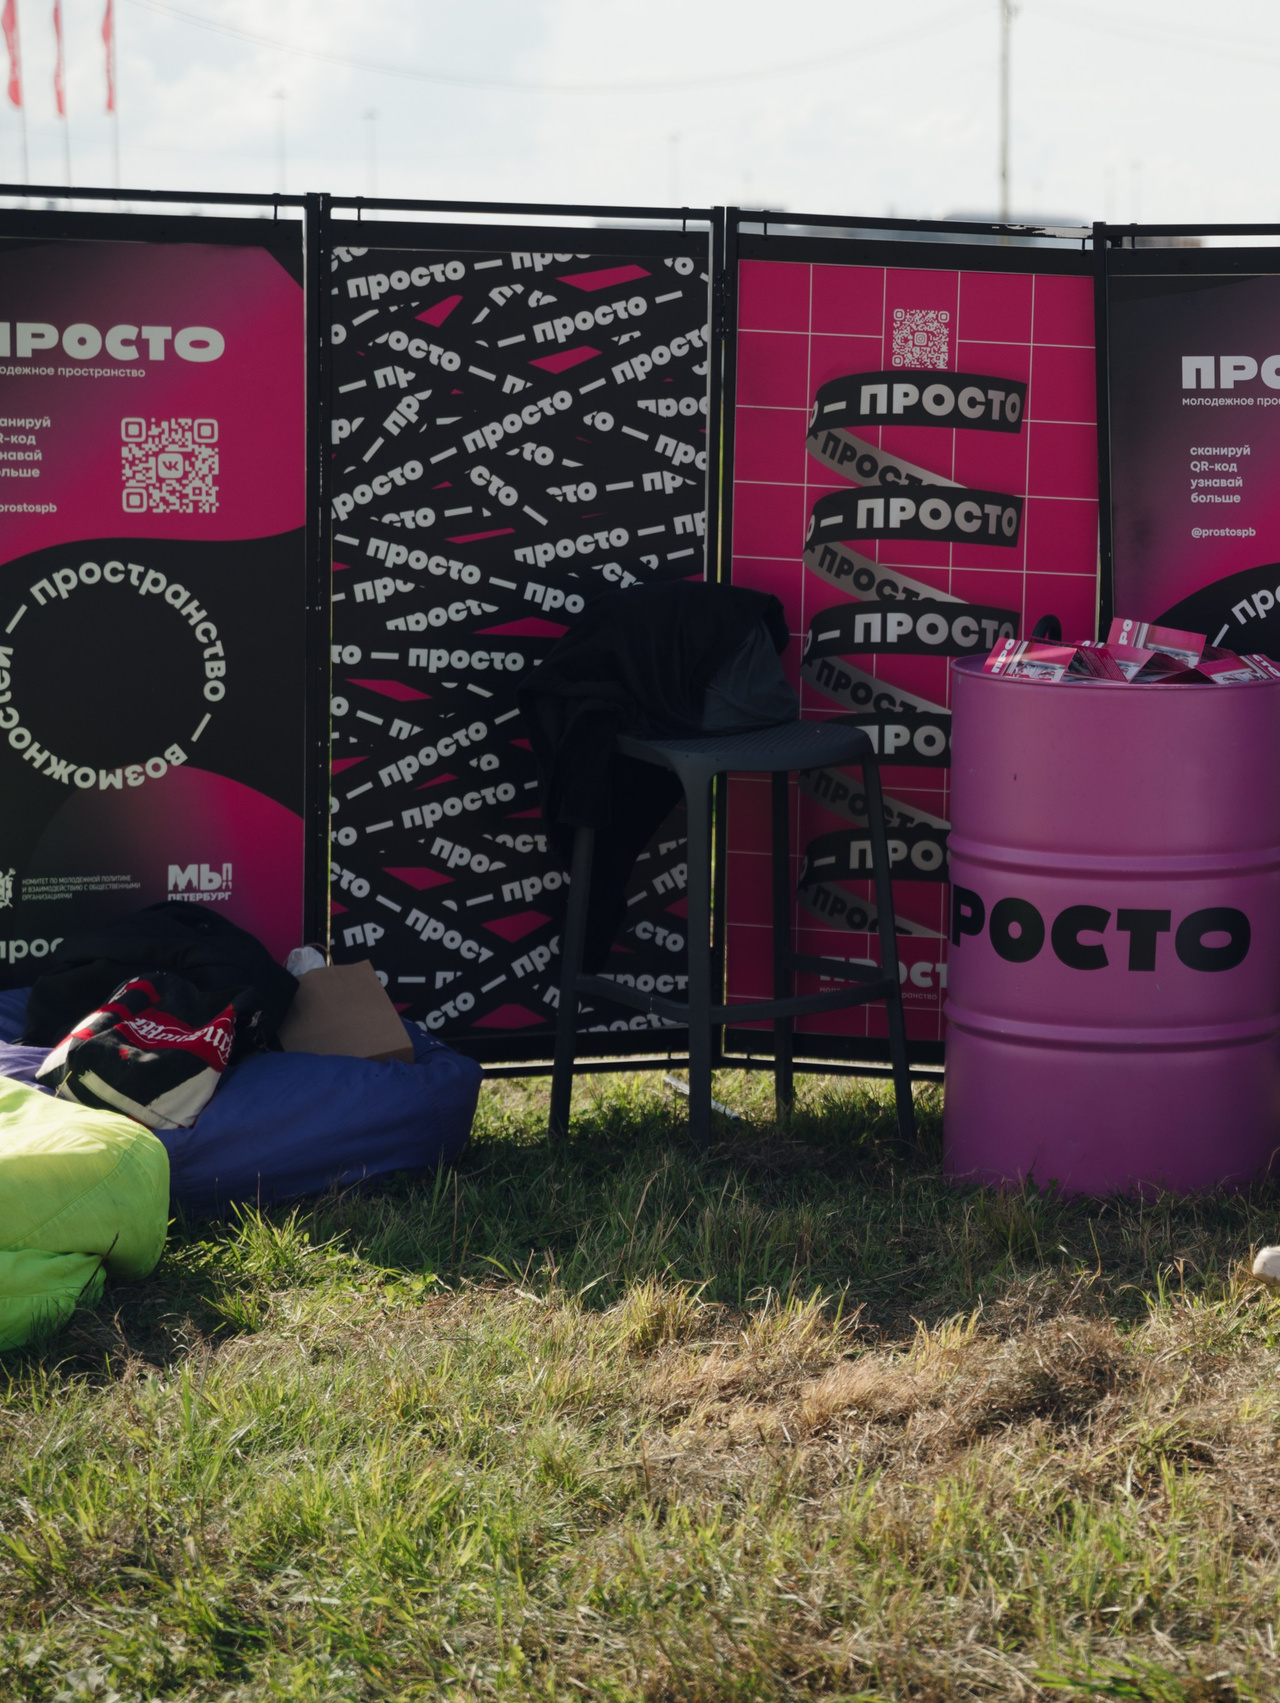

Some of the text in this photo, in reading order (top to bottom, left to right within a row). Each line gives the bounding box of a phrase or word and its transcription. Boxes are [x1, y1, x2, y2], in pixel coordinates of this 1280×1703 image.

[347, 261, 465, 300] просто
[533, 297, 647, 343] просто
[0, 322, 225, 362] РОСТО
[375, 331, 461, 371] осто
[0, 366, 145, 378] одежное пространство
[860, 383, 1021, 423] ПРОСТО
[1182, 397, 1254, 407] молодежное
[0, 416, 51, 430] анируй
[463, 391, 572, 453] просто
[0, 450, 42, 461] навай
[1190, 445, 1251, 457] сканируй
[1190, 461, 1238, 473] QR-код
[0, 467, 40, 478] льше
[332, 460, 423, 522] росто
[1190, 476, 1243, 489] узнавай
[857, 497, 1016, 537] ПРОСТО
[1191, 492, 1241, 503] больше
[1191, 527, 1256, 538] @prostospb
[367, 538, 584, 613] просто про
[30, 560, 226, 702] пространство
[409, 648, 524, 673] просто
[379, 722, 487, 787] просто
[402, 783, 515, 828] просто
[636, 921, 684, 951] сто
[952, 884, 1251, 973] РОСТО
